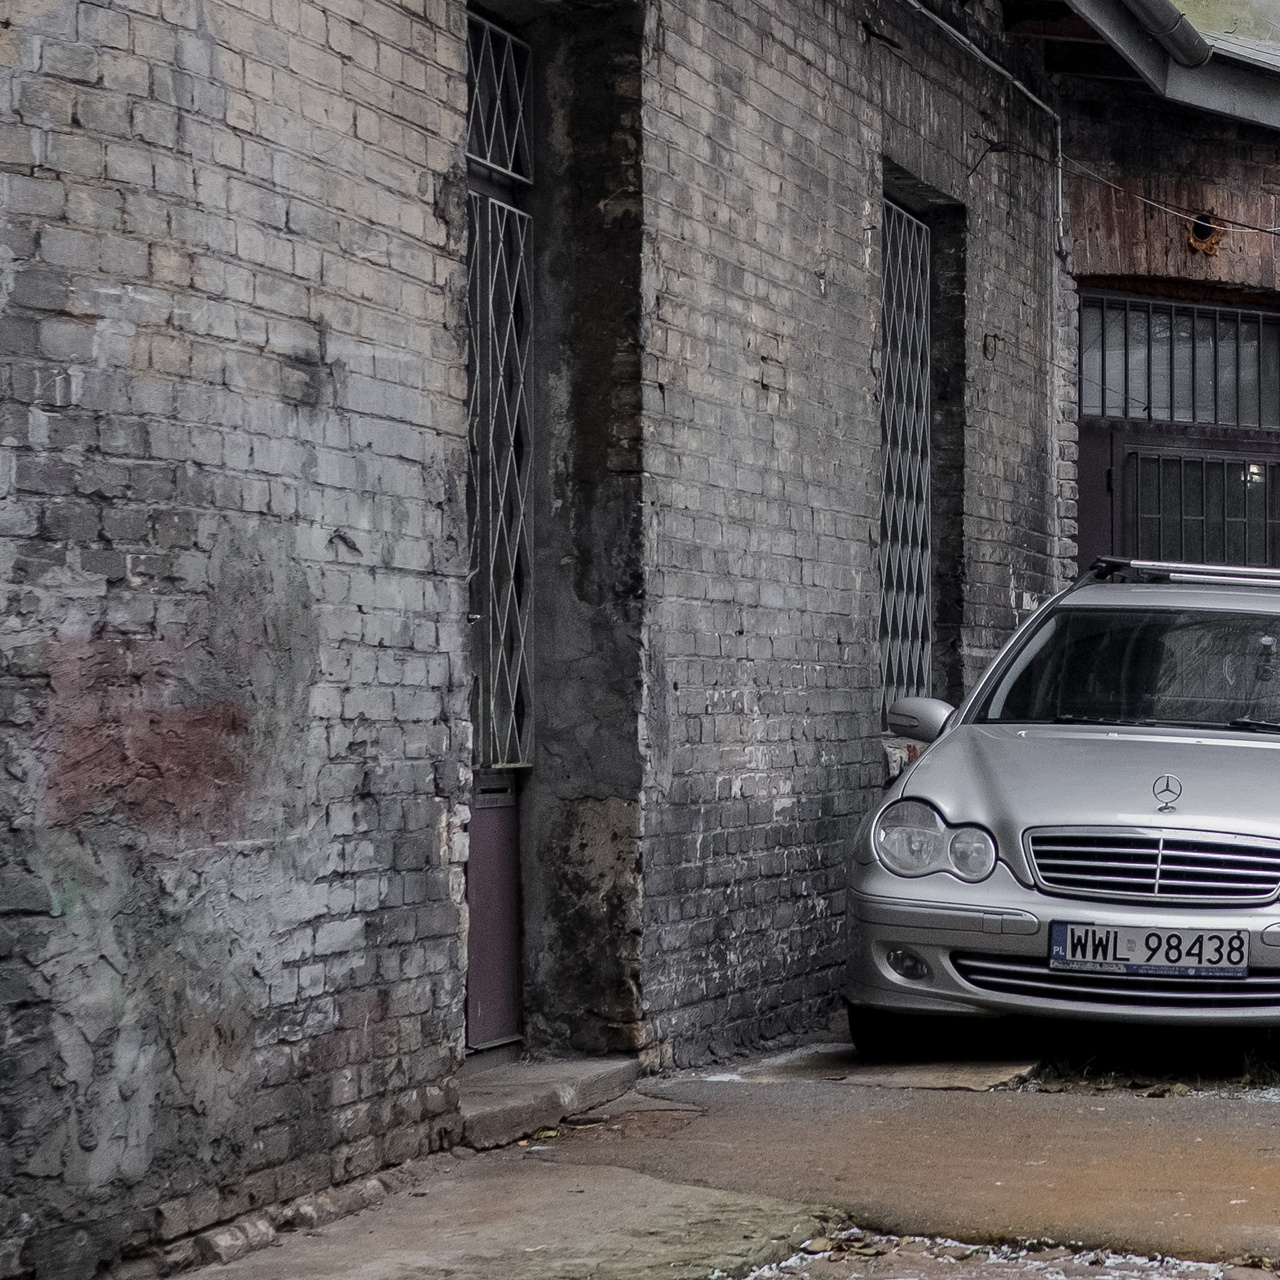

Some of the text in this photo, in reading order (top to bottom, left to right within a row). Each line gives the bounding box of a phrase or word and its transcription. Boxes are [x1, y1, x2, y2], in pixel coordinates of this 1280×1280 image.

[1053, 946, 1066, 956] PL
[1070, 927, 1131, 963] WWL
[1143, 932, 1245, 966] 98438
